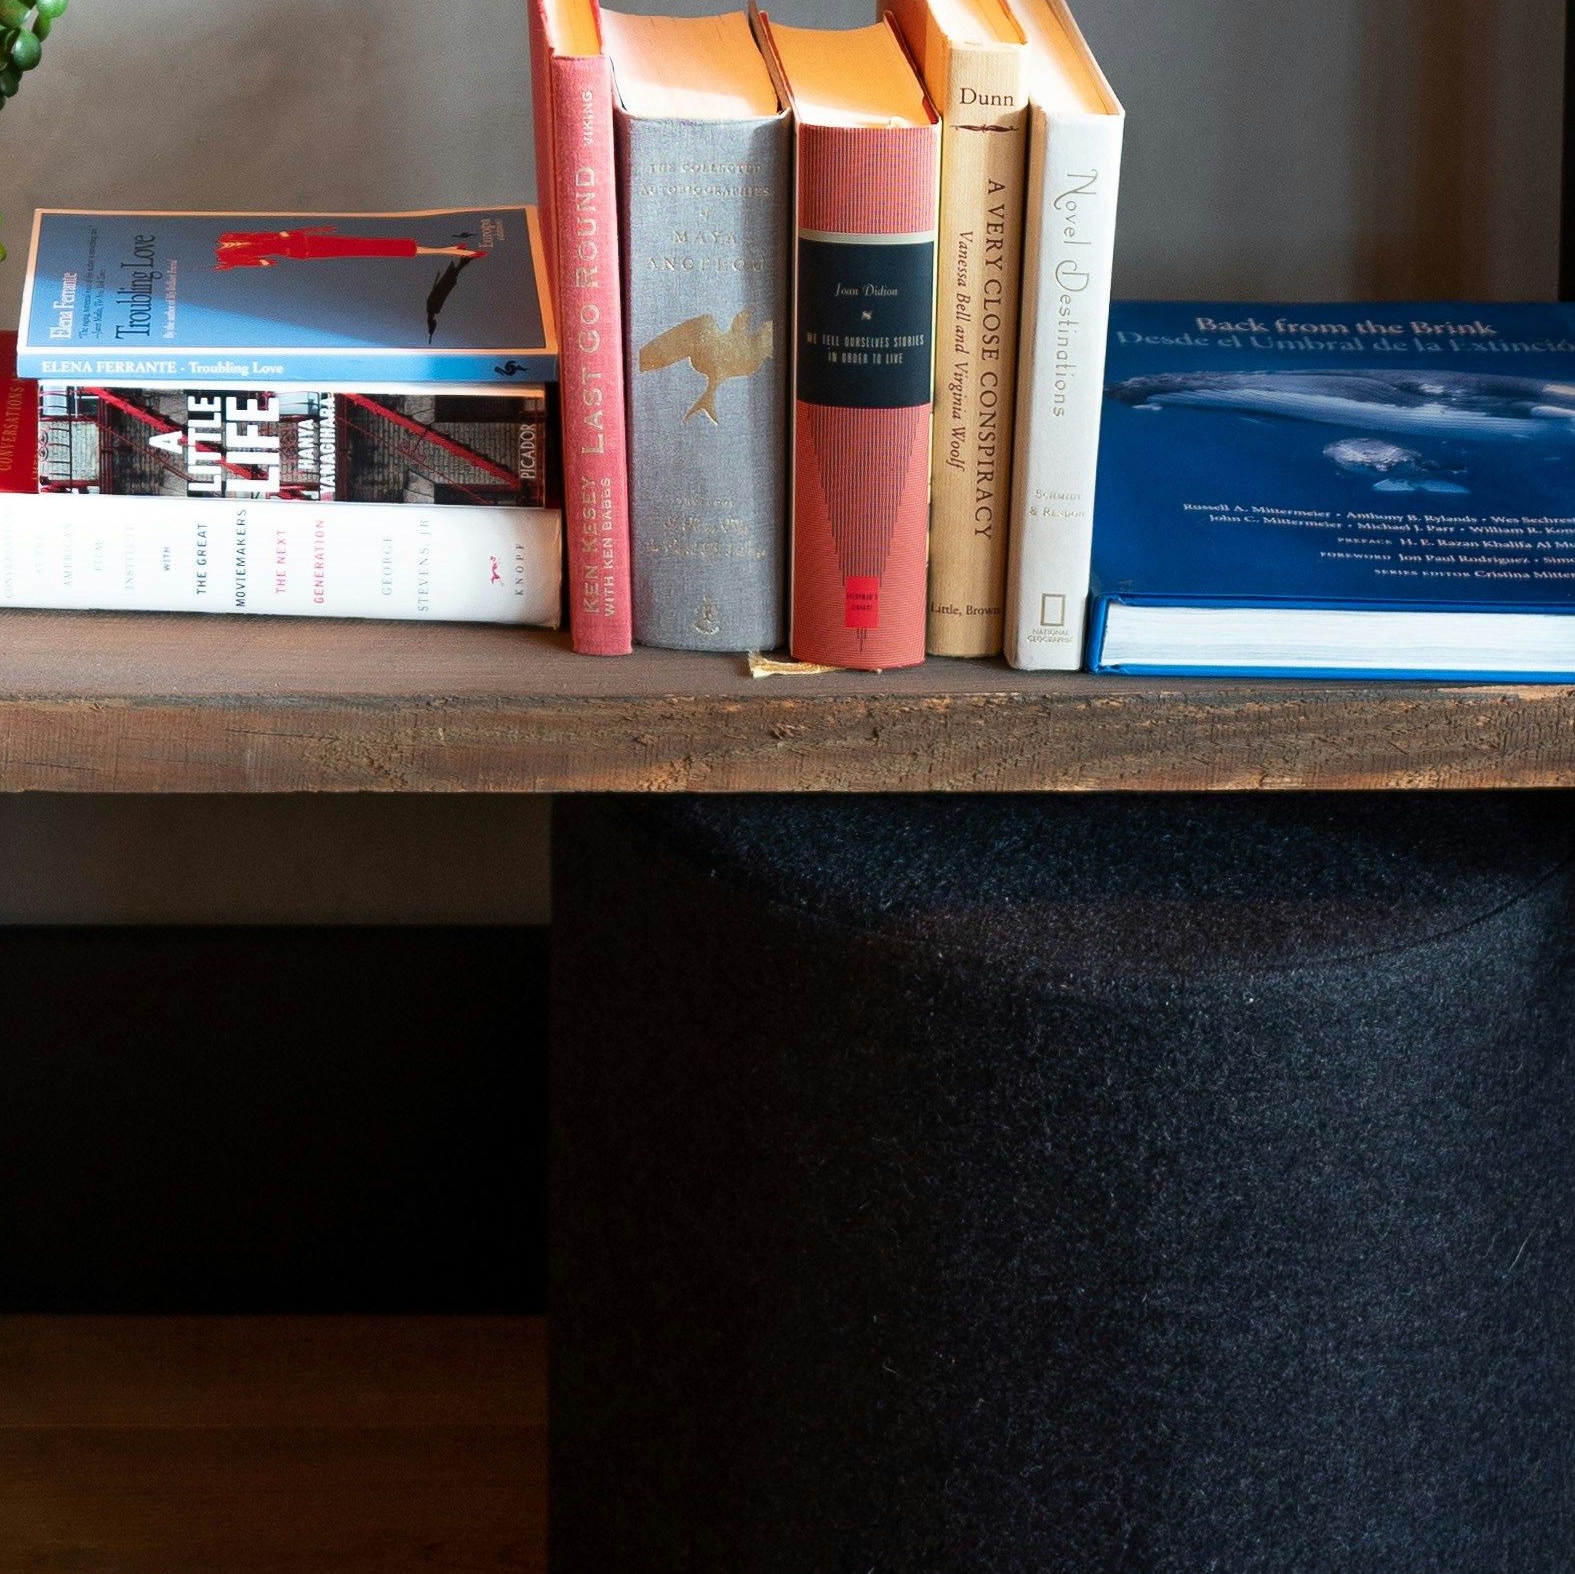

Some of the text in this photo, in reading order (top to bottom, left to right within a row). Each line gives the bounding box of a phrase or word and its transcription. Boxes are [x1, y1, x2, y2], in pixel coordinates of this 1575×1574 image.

[583, 89, 594, 148] VIKING
[959, 87, 1014, 107] Dunn
[115, 234, 163, 340] Troubling Love
[575, 165, 605, 456] LAST GO ROUND
[834, 282, 899, 298] Joan Didion
[1052, 168, 1098, 418] Novel Destinations
[1195, 317, 1498, 337] Back from the Brink
[945, 229, 974, 472] Vanessa Bell and Virginia Woolf
[974, 178, 1006, 540] A VERY CLOSE CONSPIRACY
[148, 430, 183, 455] A
[187, 395, 222, 492] LITTLE
[225, 396, 280, 492] LIFE
[297, 418, 314, 469] HANYA
[318, 395, 336, 495] YANAGIHARA
[520, 422, 536, 480] PICADOR
[196, 522, 208, 595] THE GREAT
[235, 508, 247, 608] MOVIEMAKERS
[275, 529, 287, 594] THE NEXT
[313, 518, 325, 604] GENERATION
[581, 475, 601, 616] KEN KESEY
